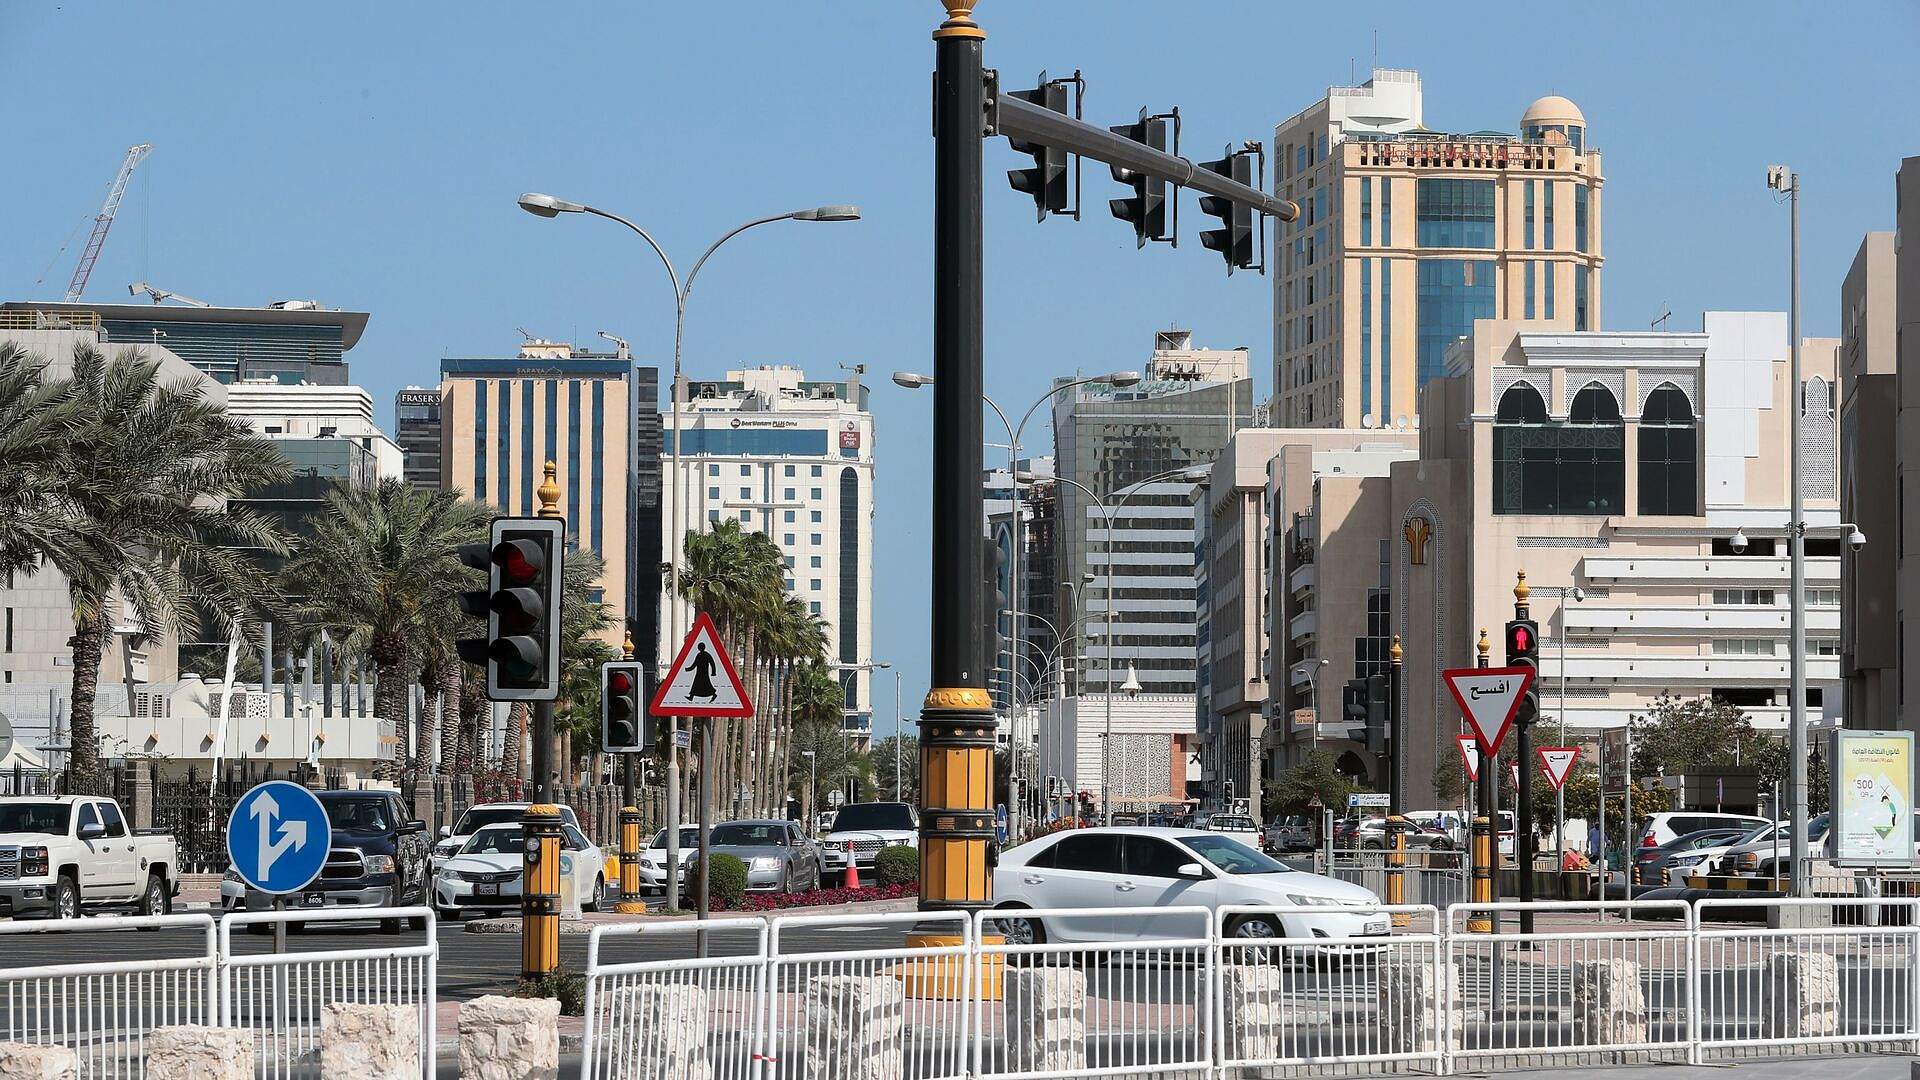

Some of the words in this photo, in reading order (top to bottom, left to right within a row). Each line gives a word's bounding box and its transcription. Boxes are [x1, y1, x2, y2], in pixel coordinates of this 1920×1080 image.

[401, 394, 434, 403] FRASER
[1470, 679, 1510, 701] افسح
[537, 784, 543, 793] 9
[1856, 779, 1873, 790] 500
